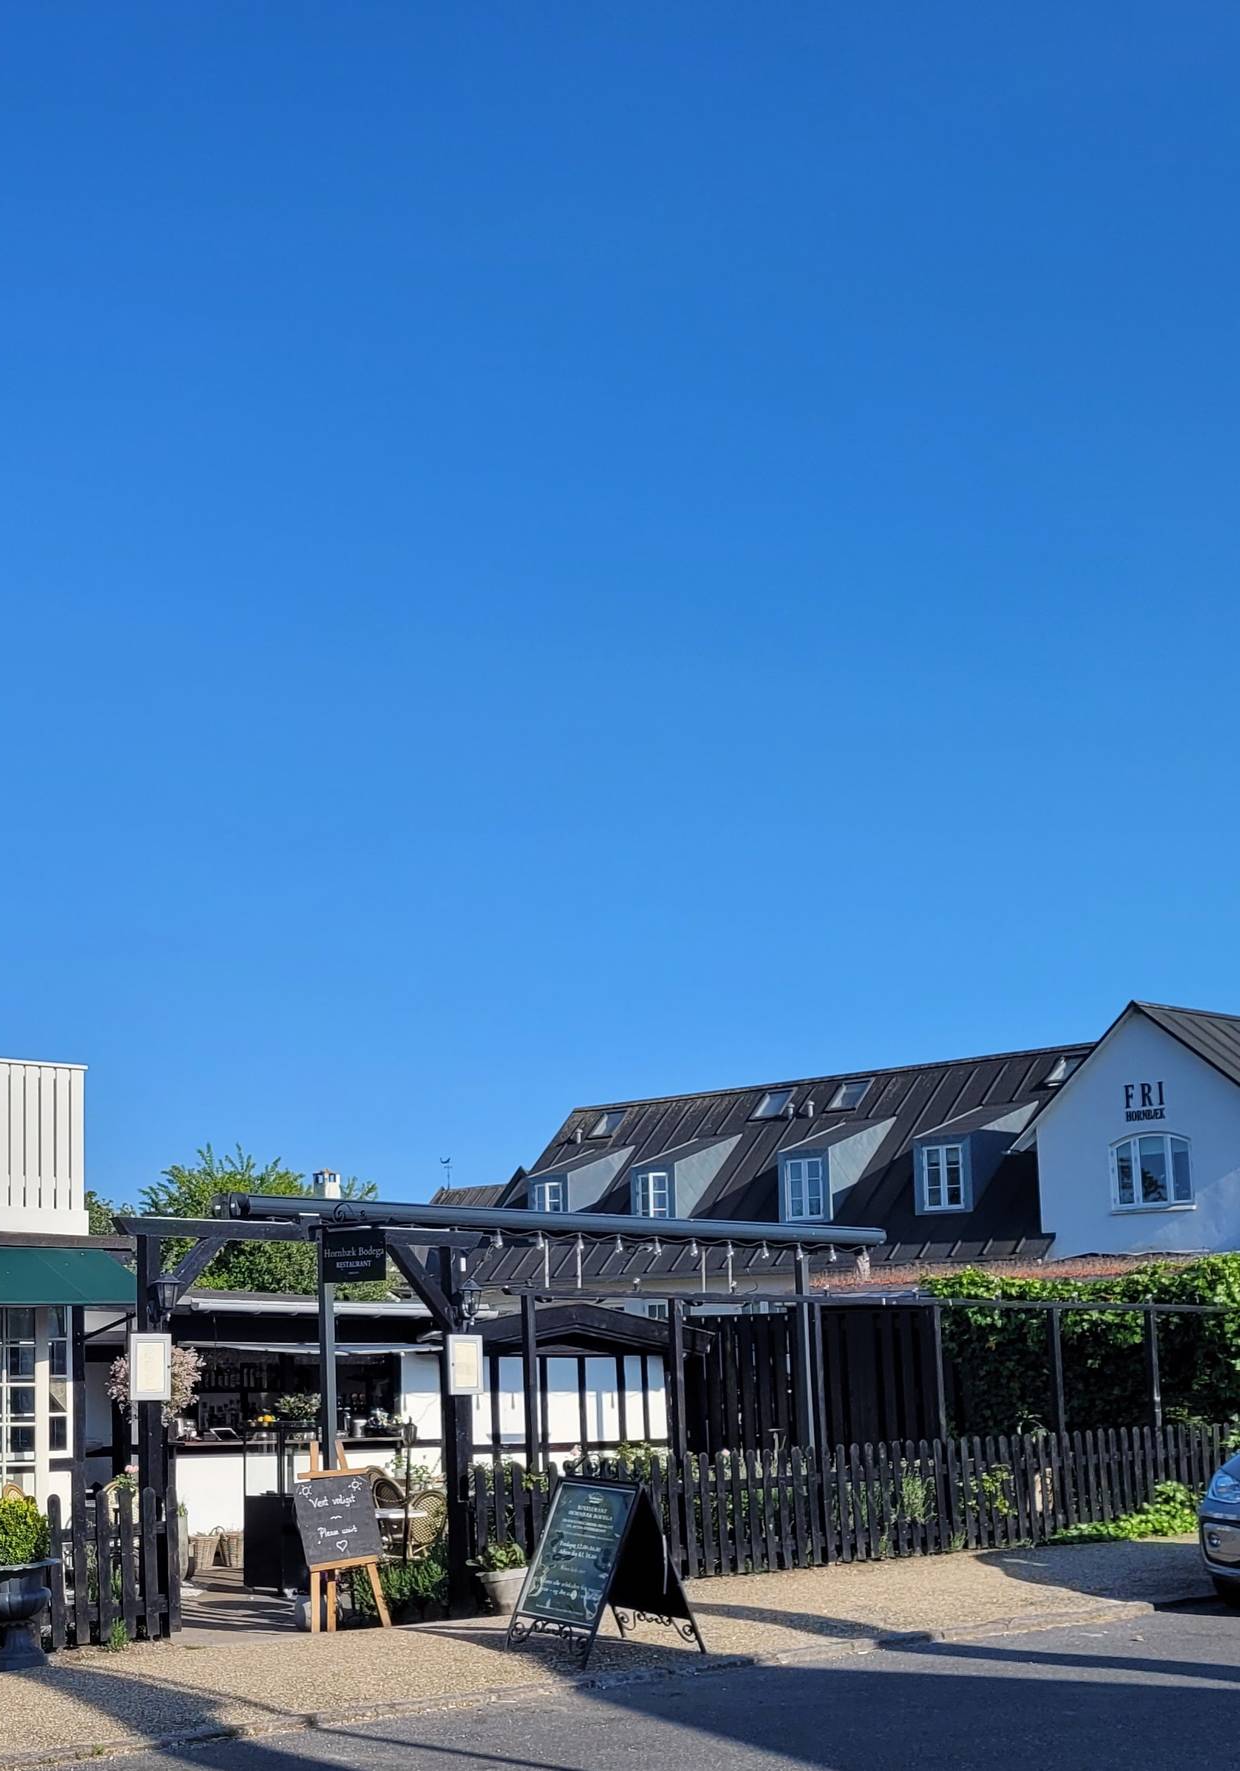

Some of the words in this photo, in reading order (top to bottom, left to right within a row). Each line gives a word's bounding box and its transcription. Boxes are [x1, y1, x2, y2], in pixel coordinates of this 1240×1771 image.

[1124, 1081, 1165, 1109] FRI
[358, 1246, 384, 1258] Bodega
[336, 1260, 371, 1268] RESTAURANT
